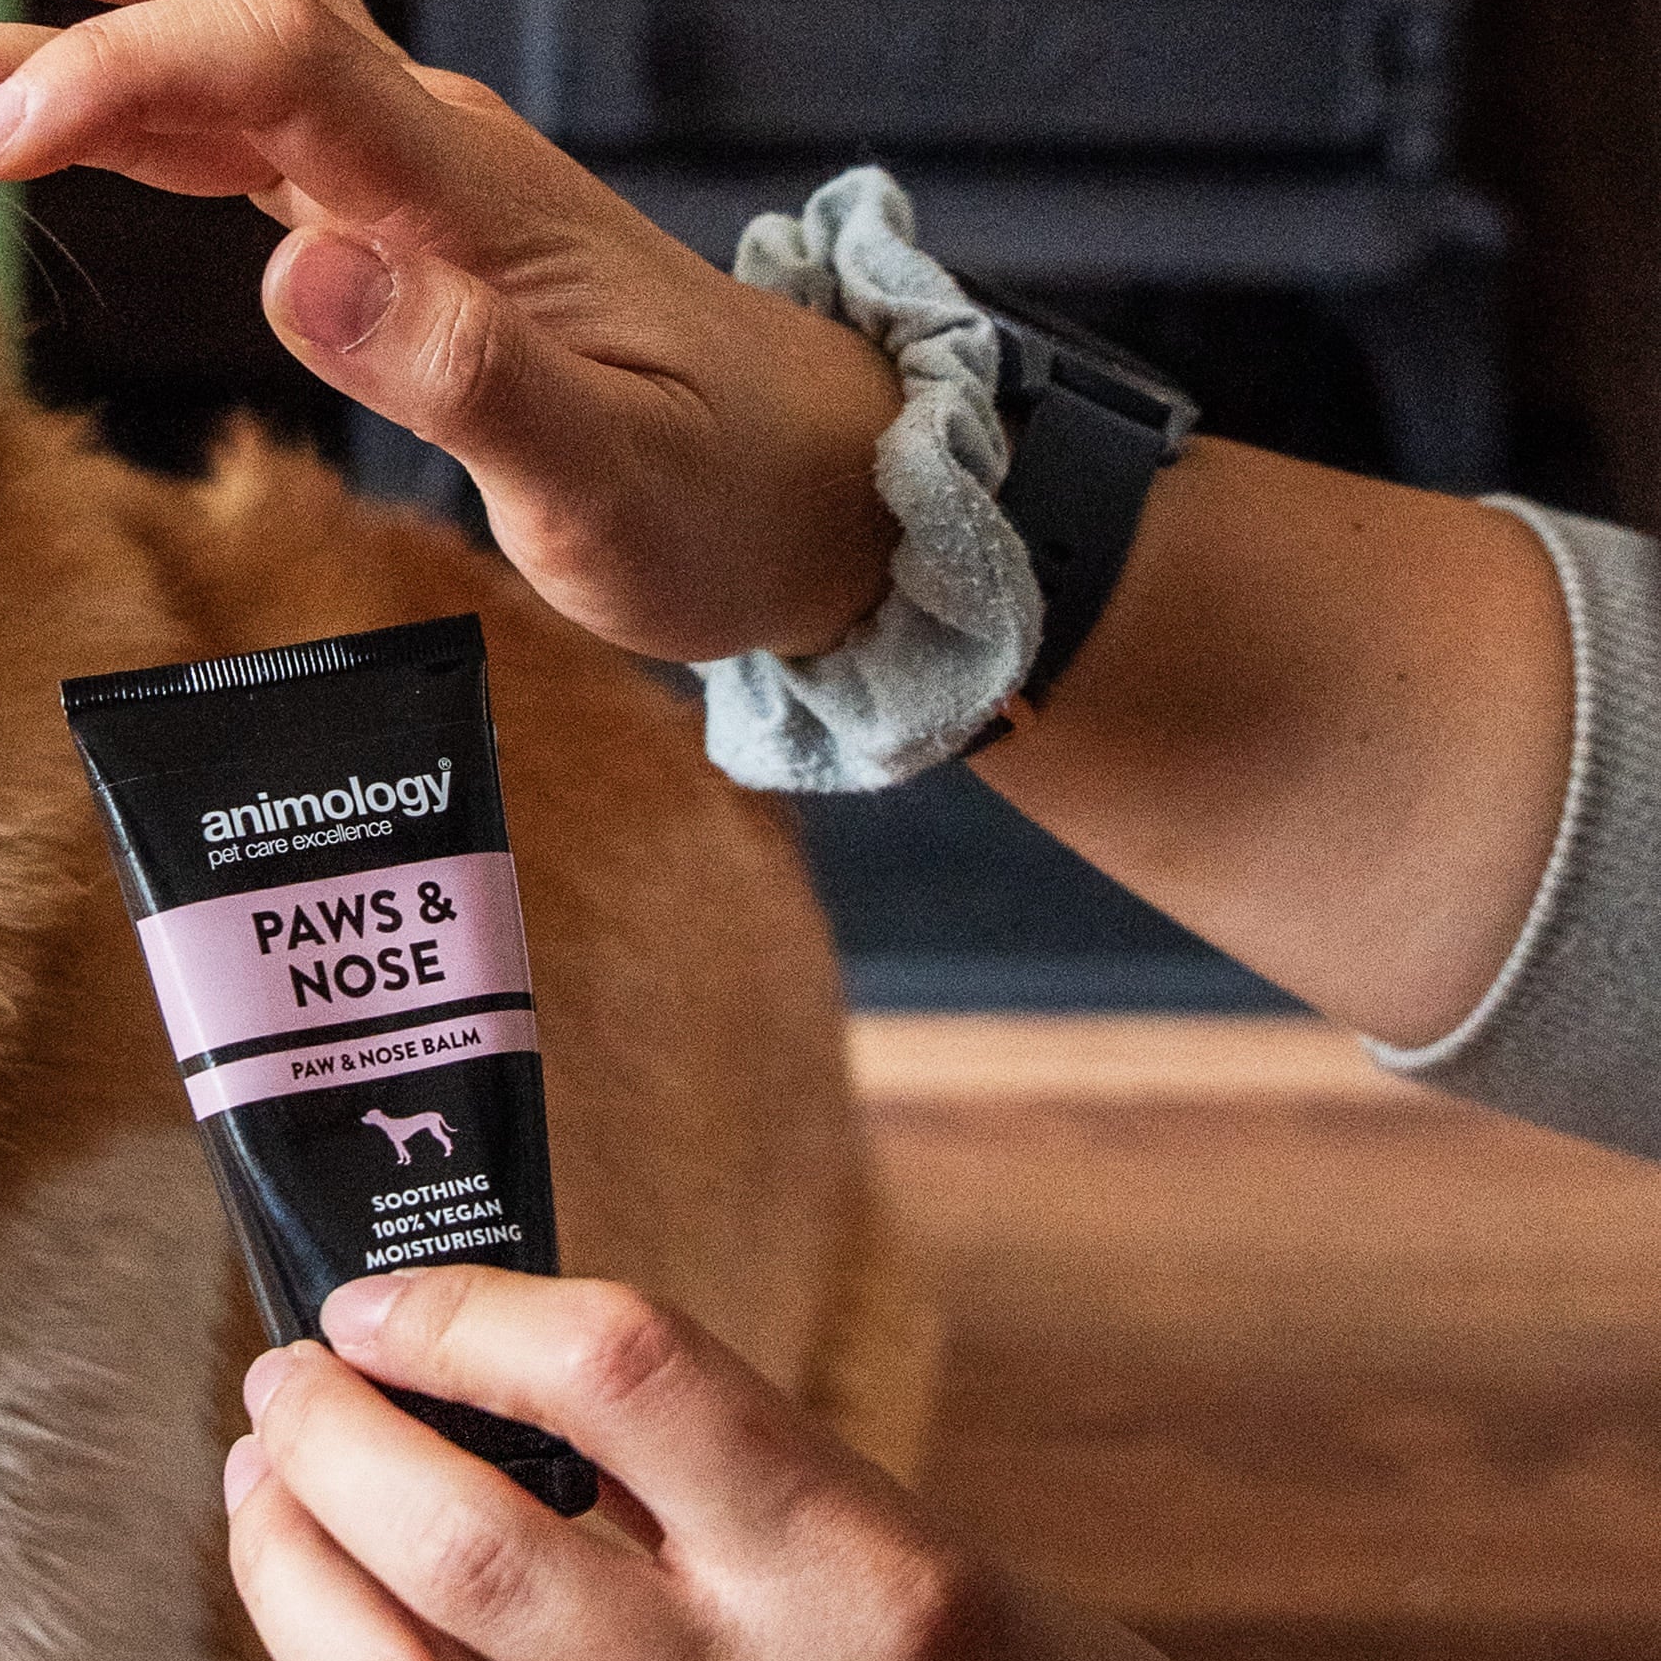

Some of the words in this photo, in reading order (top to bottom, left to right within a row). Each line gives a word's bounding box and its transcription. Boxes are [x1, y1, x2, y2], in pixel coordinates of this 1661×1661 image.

[208, 842, 242, 870] pet
[245, 836, 289, 860] care
[292, 816, 393, 851] excellence
[252, 889, 403, 955] PAWS
[417, 880, 458, 925] &
[288, 939, 446, 1007] NOSE
[292, 1056, 335, 1080] PAW
[341, 1054, 355, 1071] &
[358, 1040, 418, 1068] NOSE
[422, 1027, 481, 1056] BALM
[371, 1173, 490, 1213] SOOTHING
[371, 1214, 426, 1239] 100%
[426, 1198, 503, 1228] VEGAN
[365, 1222, 522, 1270] MOISTURISING
